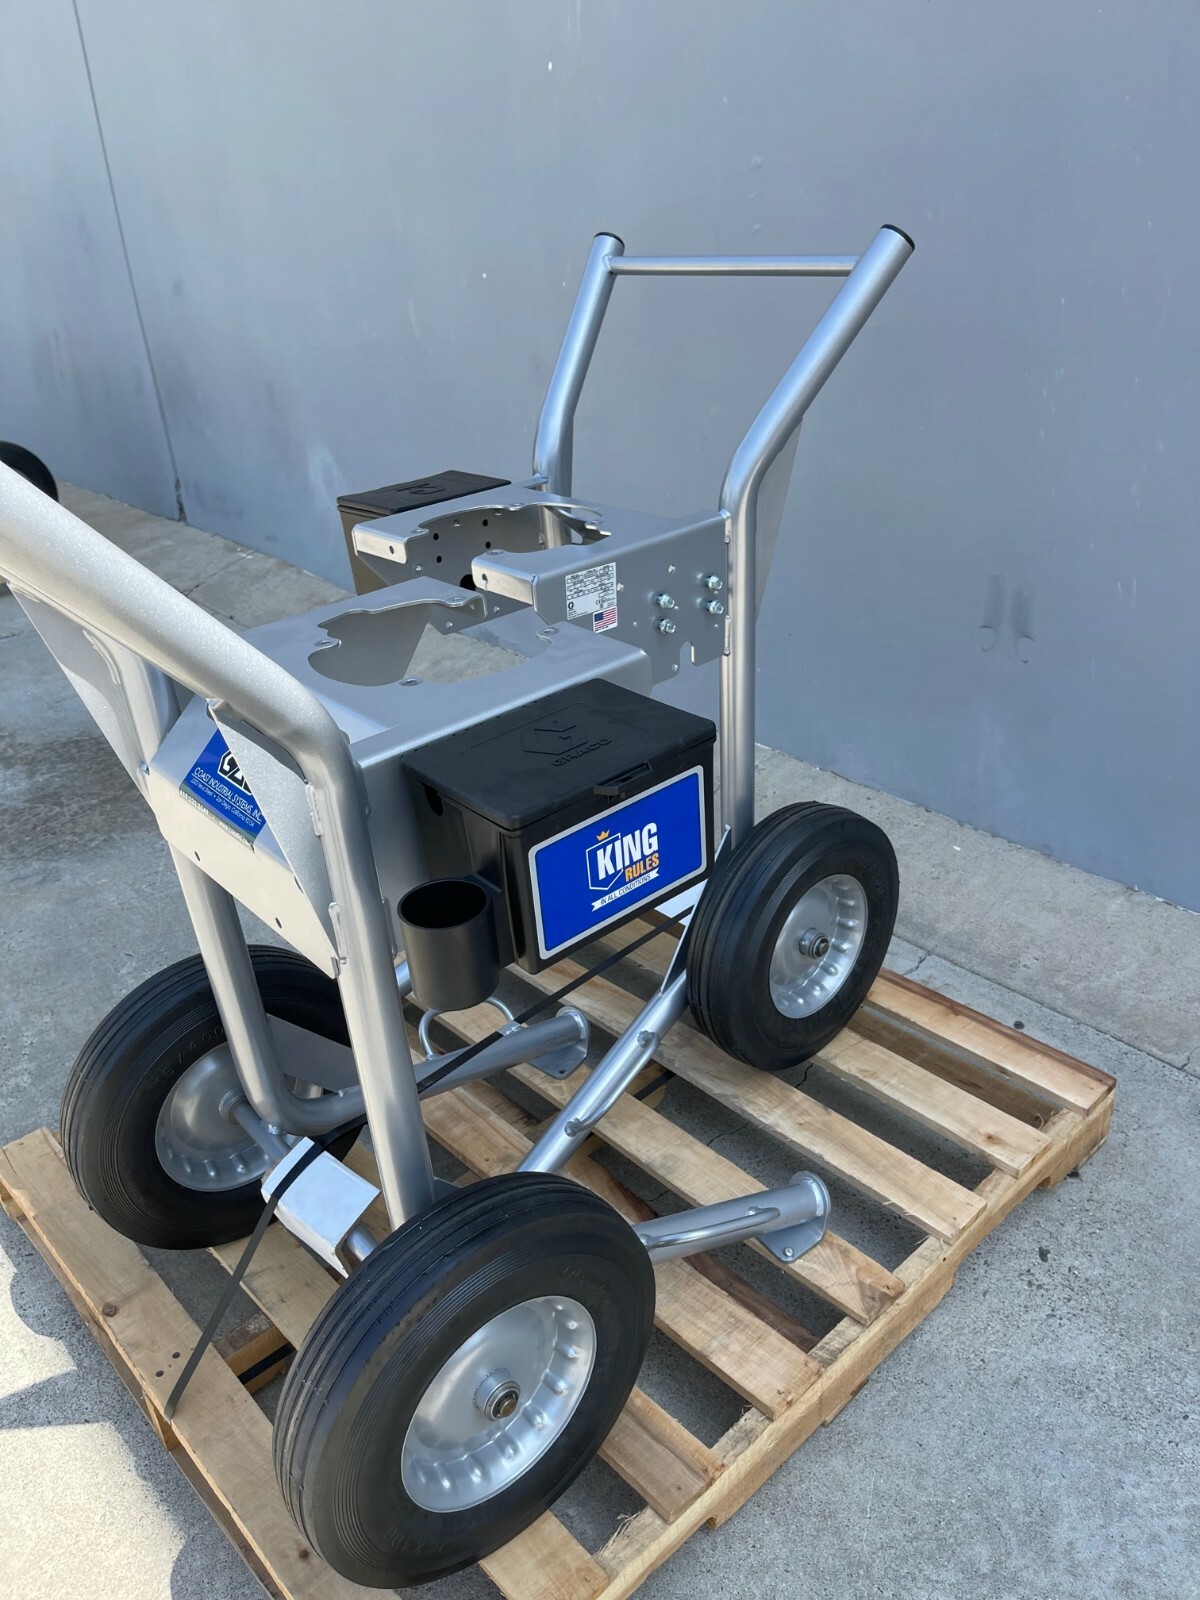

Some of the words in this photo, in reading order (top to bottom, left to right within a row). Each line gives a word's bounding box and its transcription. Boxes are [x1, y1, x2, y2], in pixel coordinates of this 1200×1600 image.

[194, 767, 211, 782] COAST
[208, 776, 233, 800] INDUSTRIAL
[596, 822, 658, 880] KING
[624, 853, 660, 882] RULES
[600, 897, 607, 905] IN
[607, 892, 618, 901] ALL
[618, 874, 651, 896] CONDITIONS
